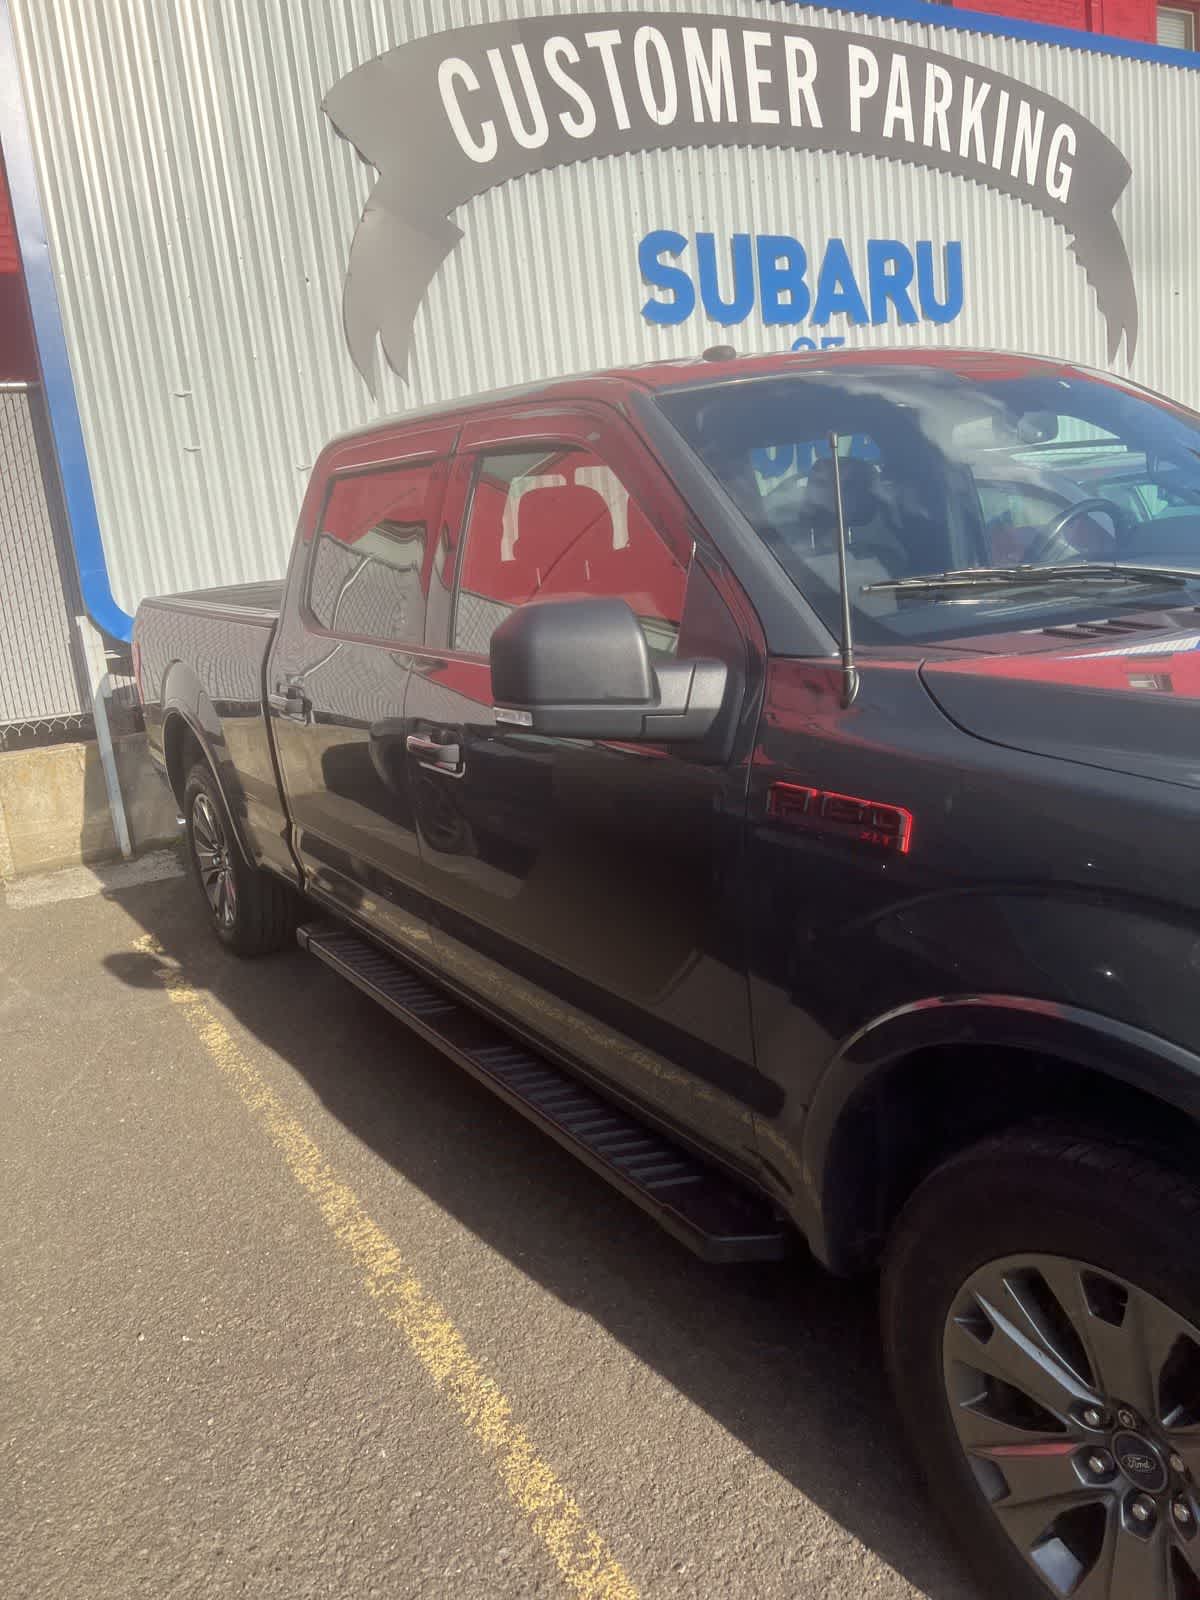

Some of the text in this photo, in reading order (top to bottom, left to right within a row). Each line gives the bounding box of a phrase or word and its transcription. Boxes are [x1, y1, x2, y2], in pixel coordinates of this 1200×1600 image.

[437, 26, 1078, 204] CUSTOMER PARKING
[639, 230, 963, 326] SUBARU
